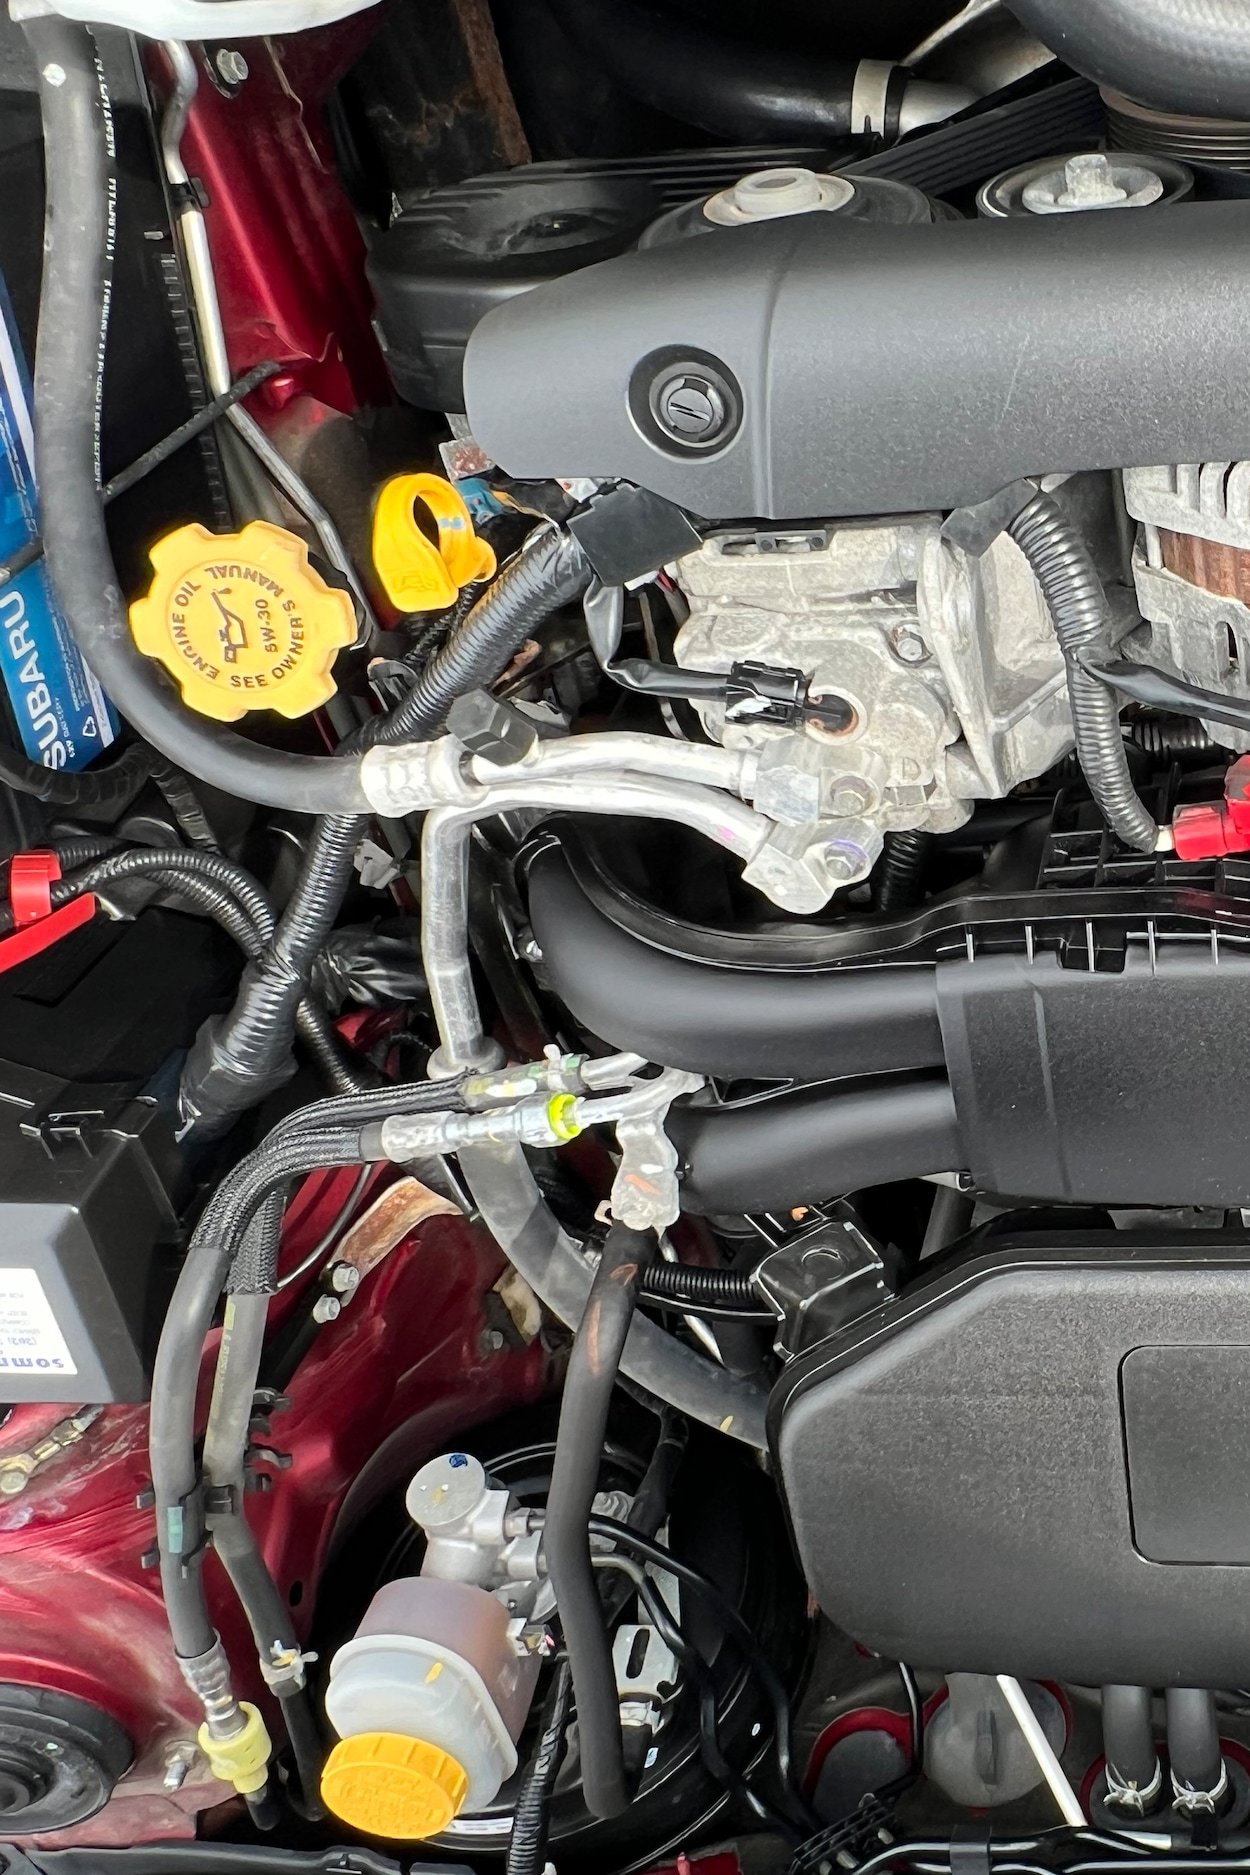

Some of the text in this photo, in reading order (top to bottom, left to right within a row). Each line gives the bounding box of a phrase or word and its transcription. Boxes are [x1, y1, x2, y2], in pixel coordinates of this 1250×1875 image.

[0, 590, 67, 770] SUBARU
[172, 580, 221, 680] ENGINE OIL
[204, 564, 305, 689] SEE OWNER'S MANUAL
[255, 598, 279, 653] 5W-30
